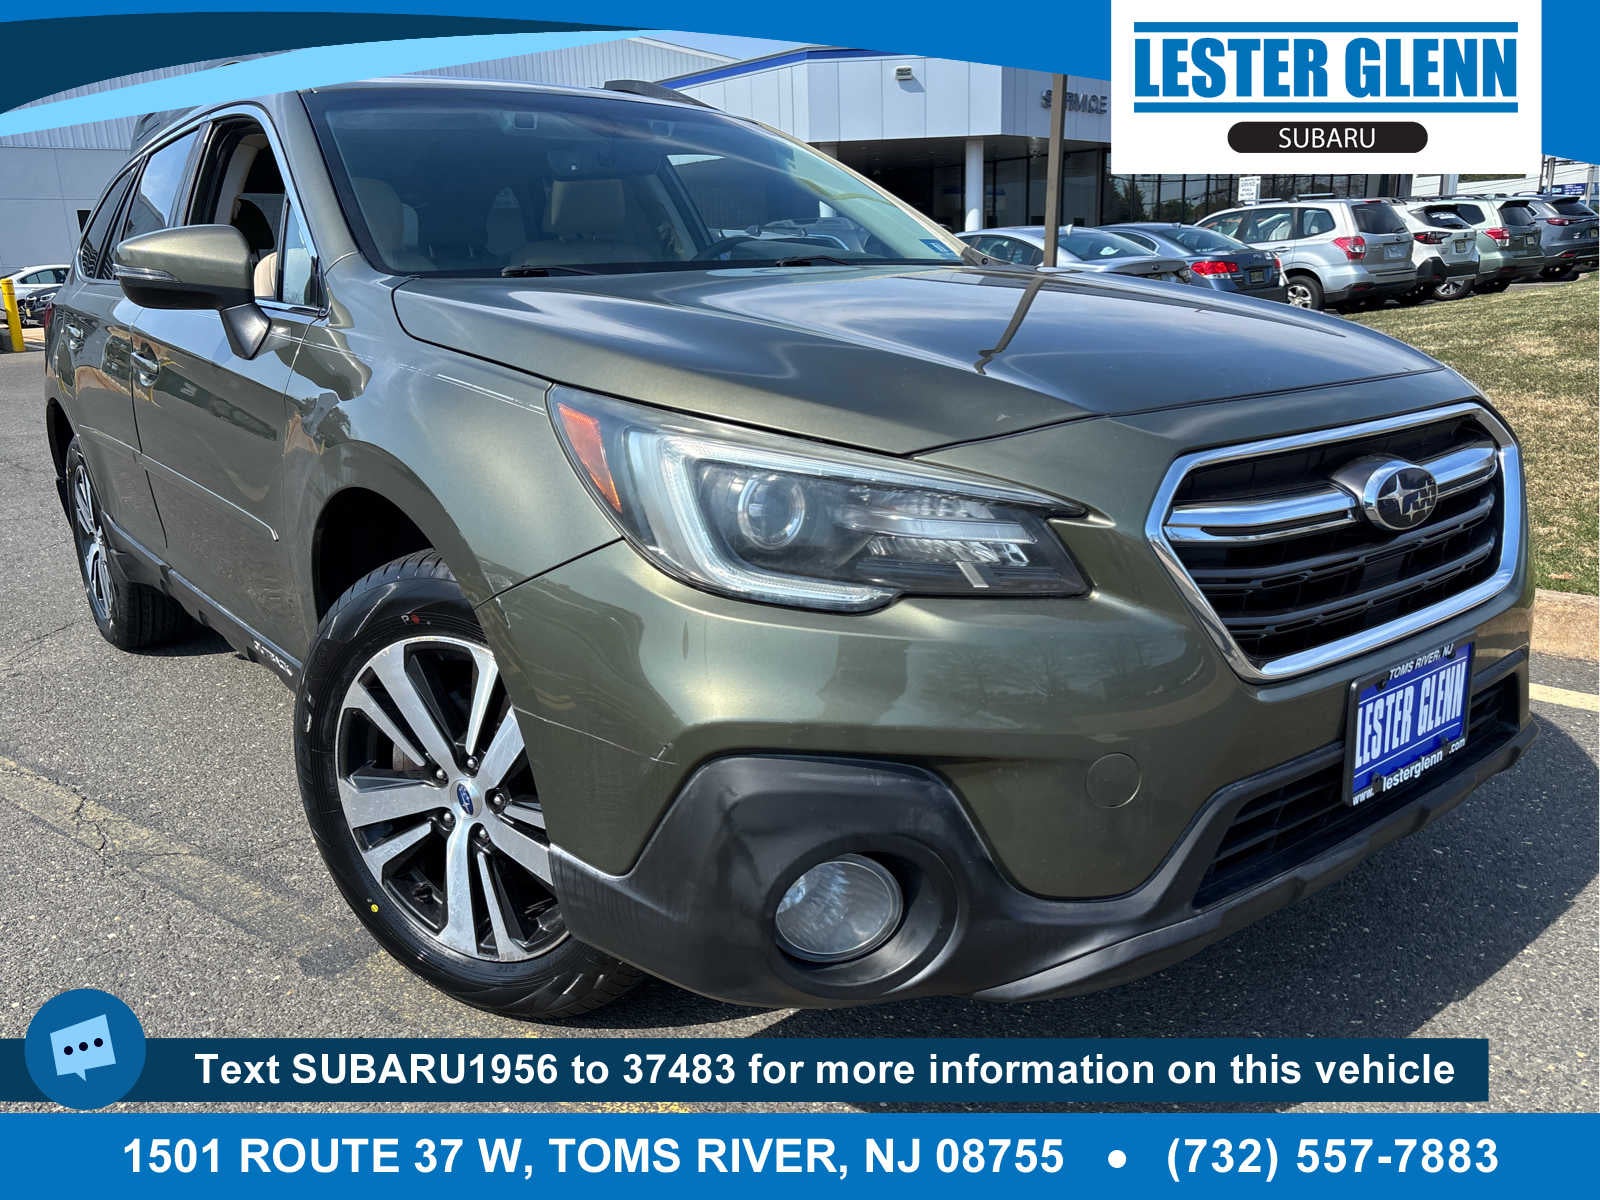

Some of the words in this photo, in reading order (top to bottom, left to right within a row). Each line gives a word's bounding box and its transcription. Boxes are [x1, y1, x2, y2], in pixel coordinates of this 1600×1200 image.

[1041, 89, 1108, 114] SRVICE
[1389, 661, 1414, 680] TOMS
[1443, 643, 1454, 658] NJ
[1355, 685, 1415, 769] LESTER
[1417, 661, 1467, 736] GLENN
